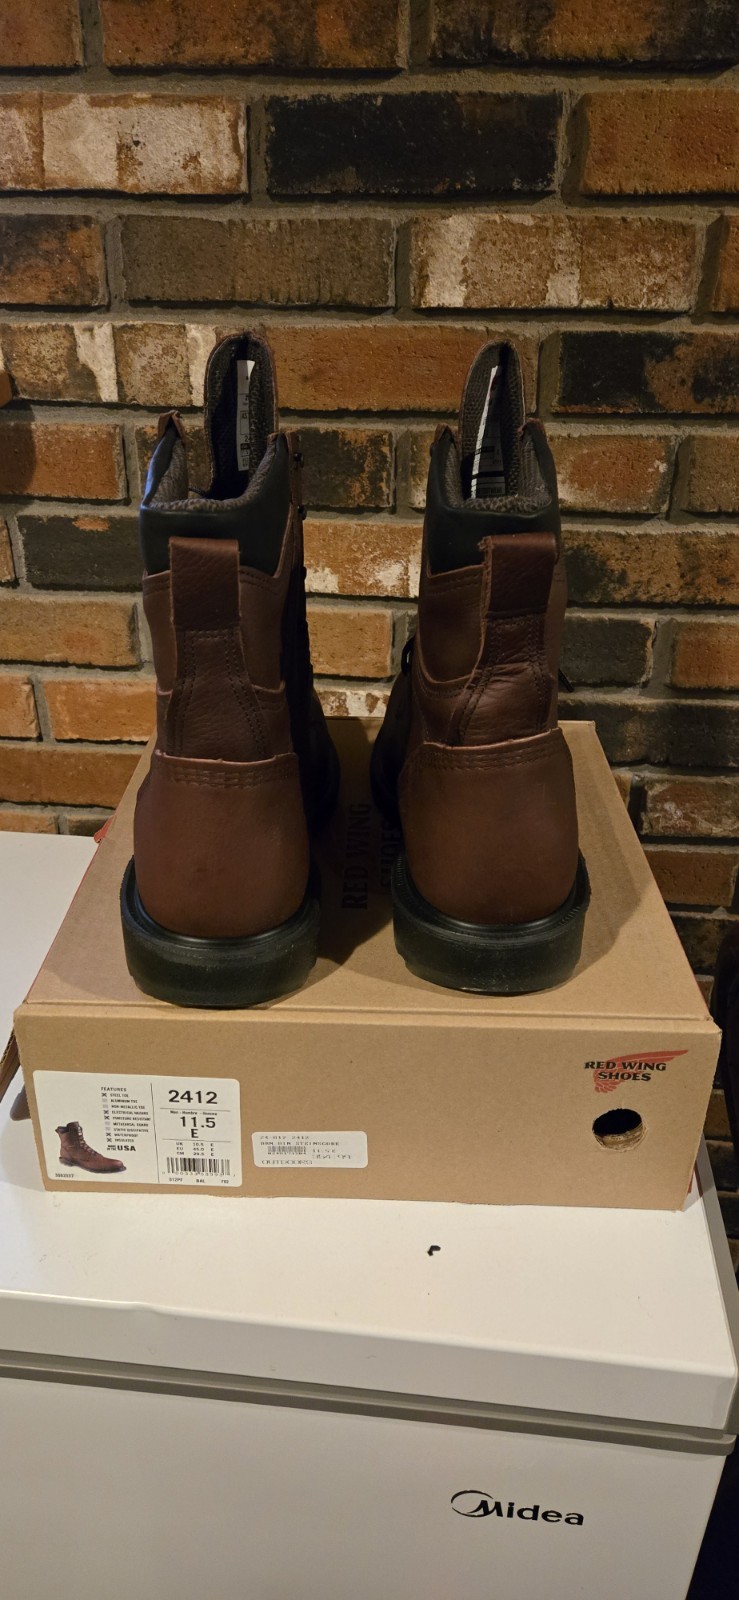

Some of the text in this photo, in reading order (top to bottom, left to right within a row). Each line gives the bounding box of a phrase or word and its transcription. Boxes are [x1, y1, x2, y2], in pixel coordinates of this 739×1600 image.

[341, 803, 371, 909] RED WING
[584, 1061, 667, 1071] RED WING
[598, 1071, 651, 1082] SHOES
[168, 1089, 218, 1105] 2412
[180, 1116, 216, 1128] 11.5
[190, 1128, 199, 1138] E
[464, 1498, 584, 1526] Midea
